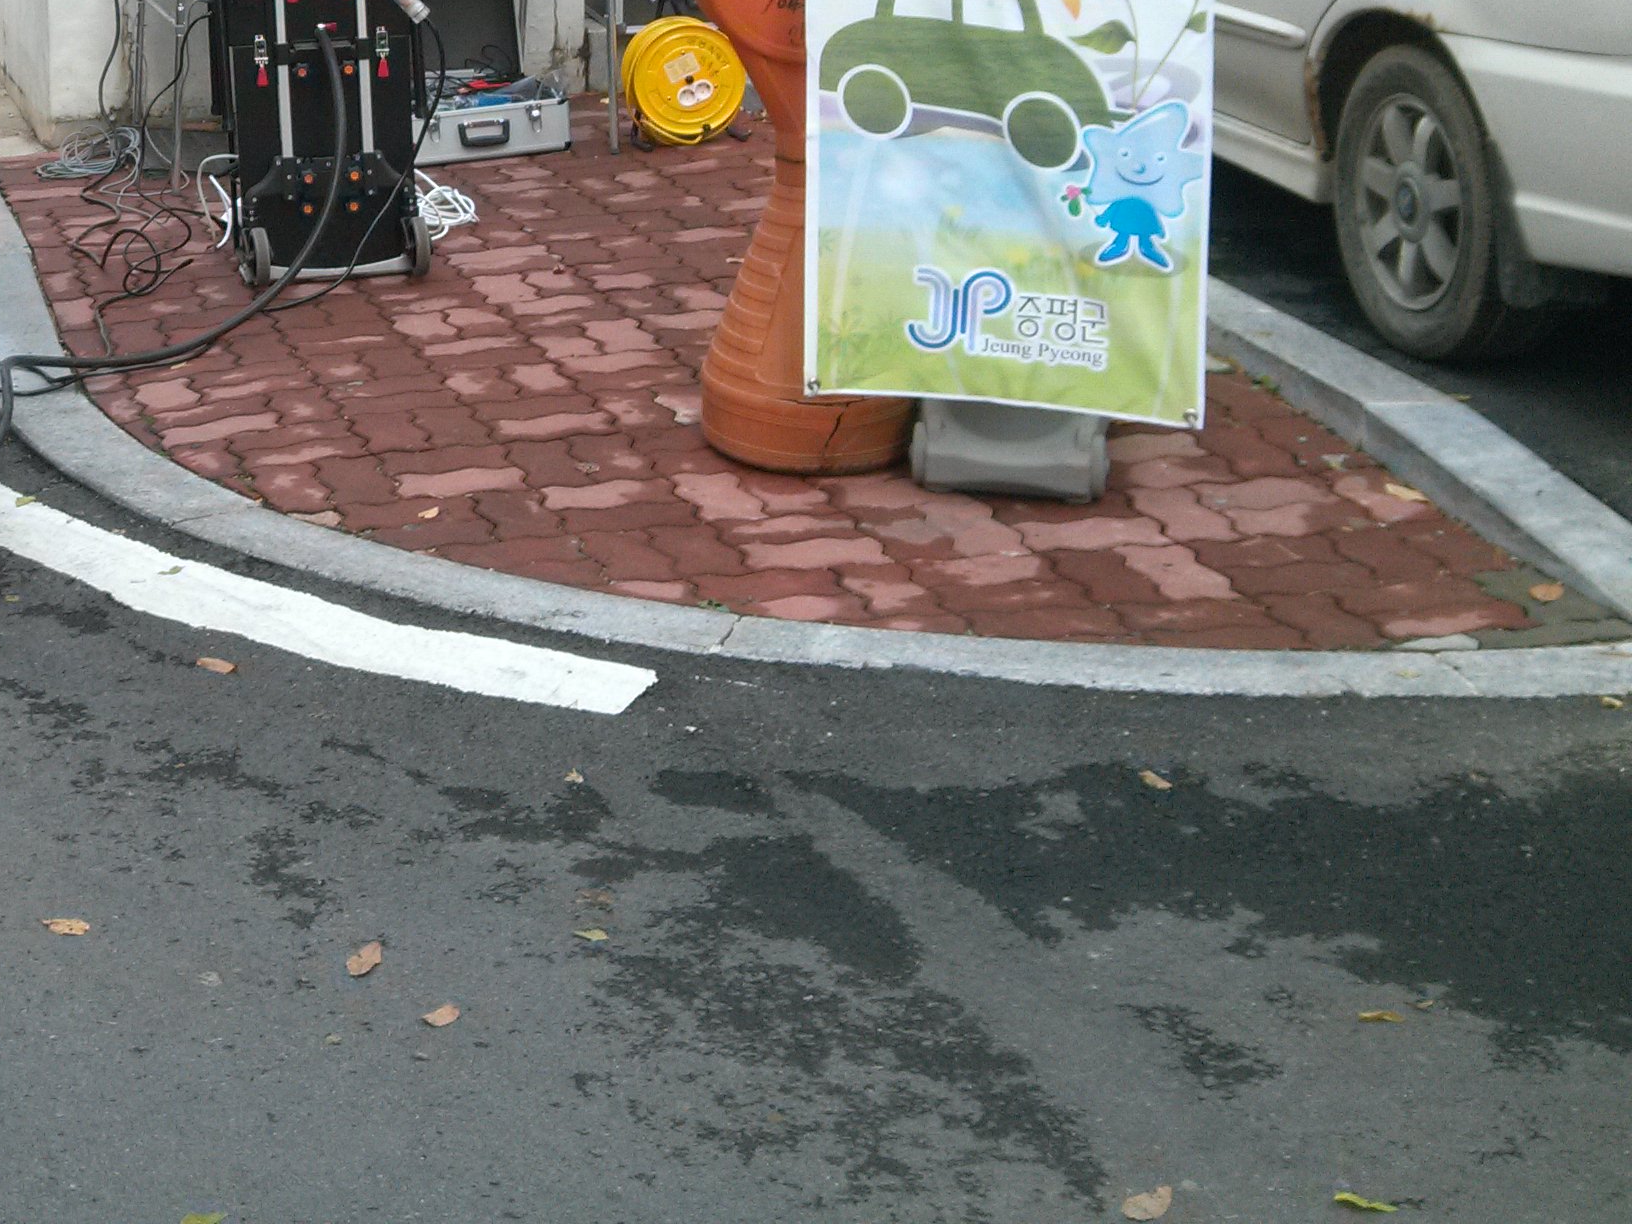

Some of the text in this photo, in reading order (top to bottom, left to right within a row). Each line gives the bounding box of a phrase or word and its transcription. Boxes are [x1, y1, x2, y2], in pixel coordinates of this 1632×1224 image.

[1017, 295, 1107, 344] 증평군
[981, 338, 1104, 367] Jeung Pyeong
